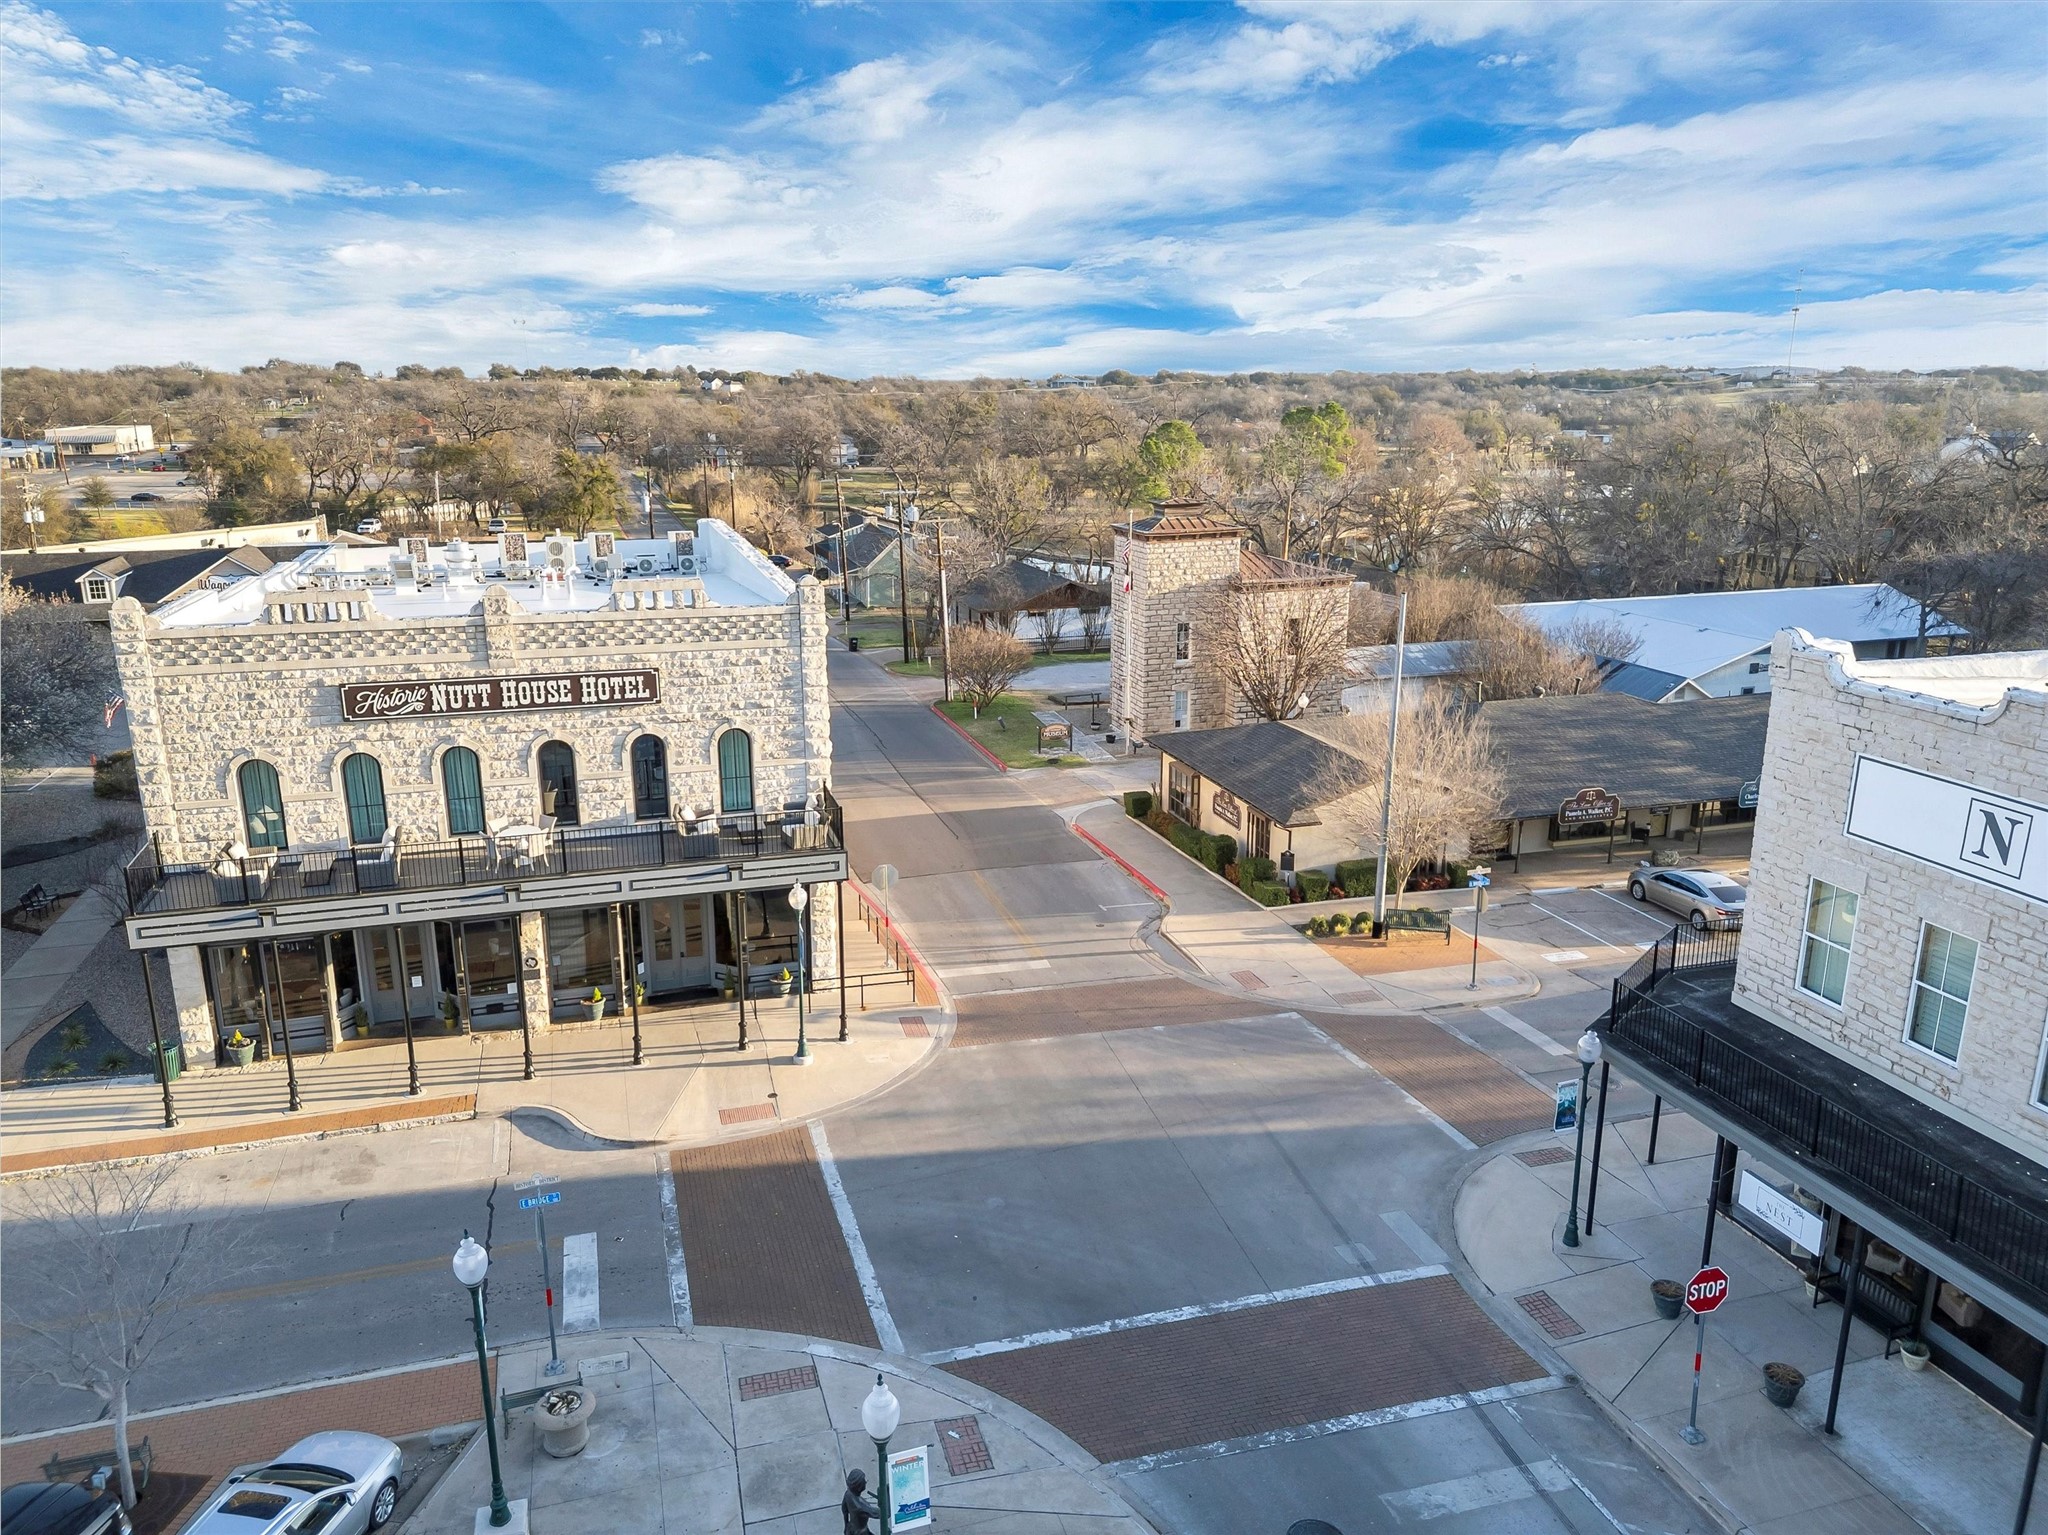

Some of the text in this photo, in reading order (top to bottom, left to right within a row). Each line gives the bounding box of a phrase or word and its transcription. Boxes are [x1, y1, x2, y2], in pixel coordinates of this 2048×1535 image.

[354, 675, 650, 715] Historic NUTT HOUSE HOTEL
[1971, 809, 2024, 866] N
[528, 1195, 550, 1206] BRIDGE
[1766, 1201, 1792, 1226] NEST
[1689, 1279, 1726, 1301] STOP
[892, 1461, 924, 1474] WINTER
